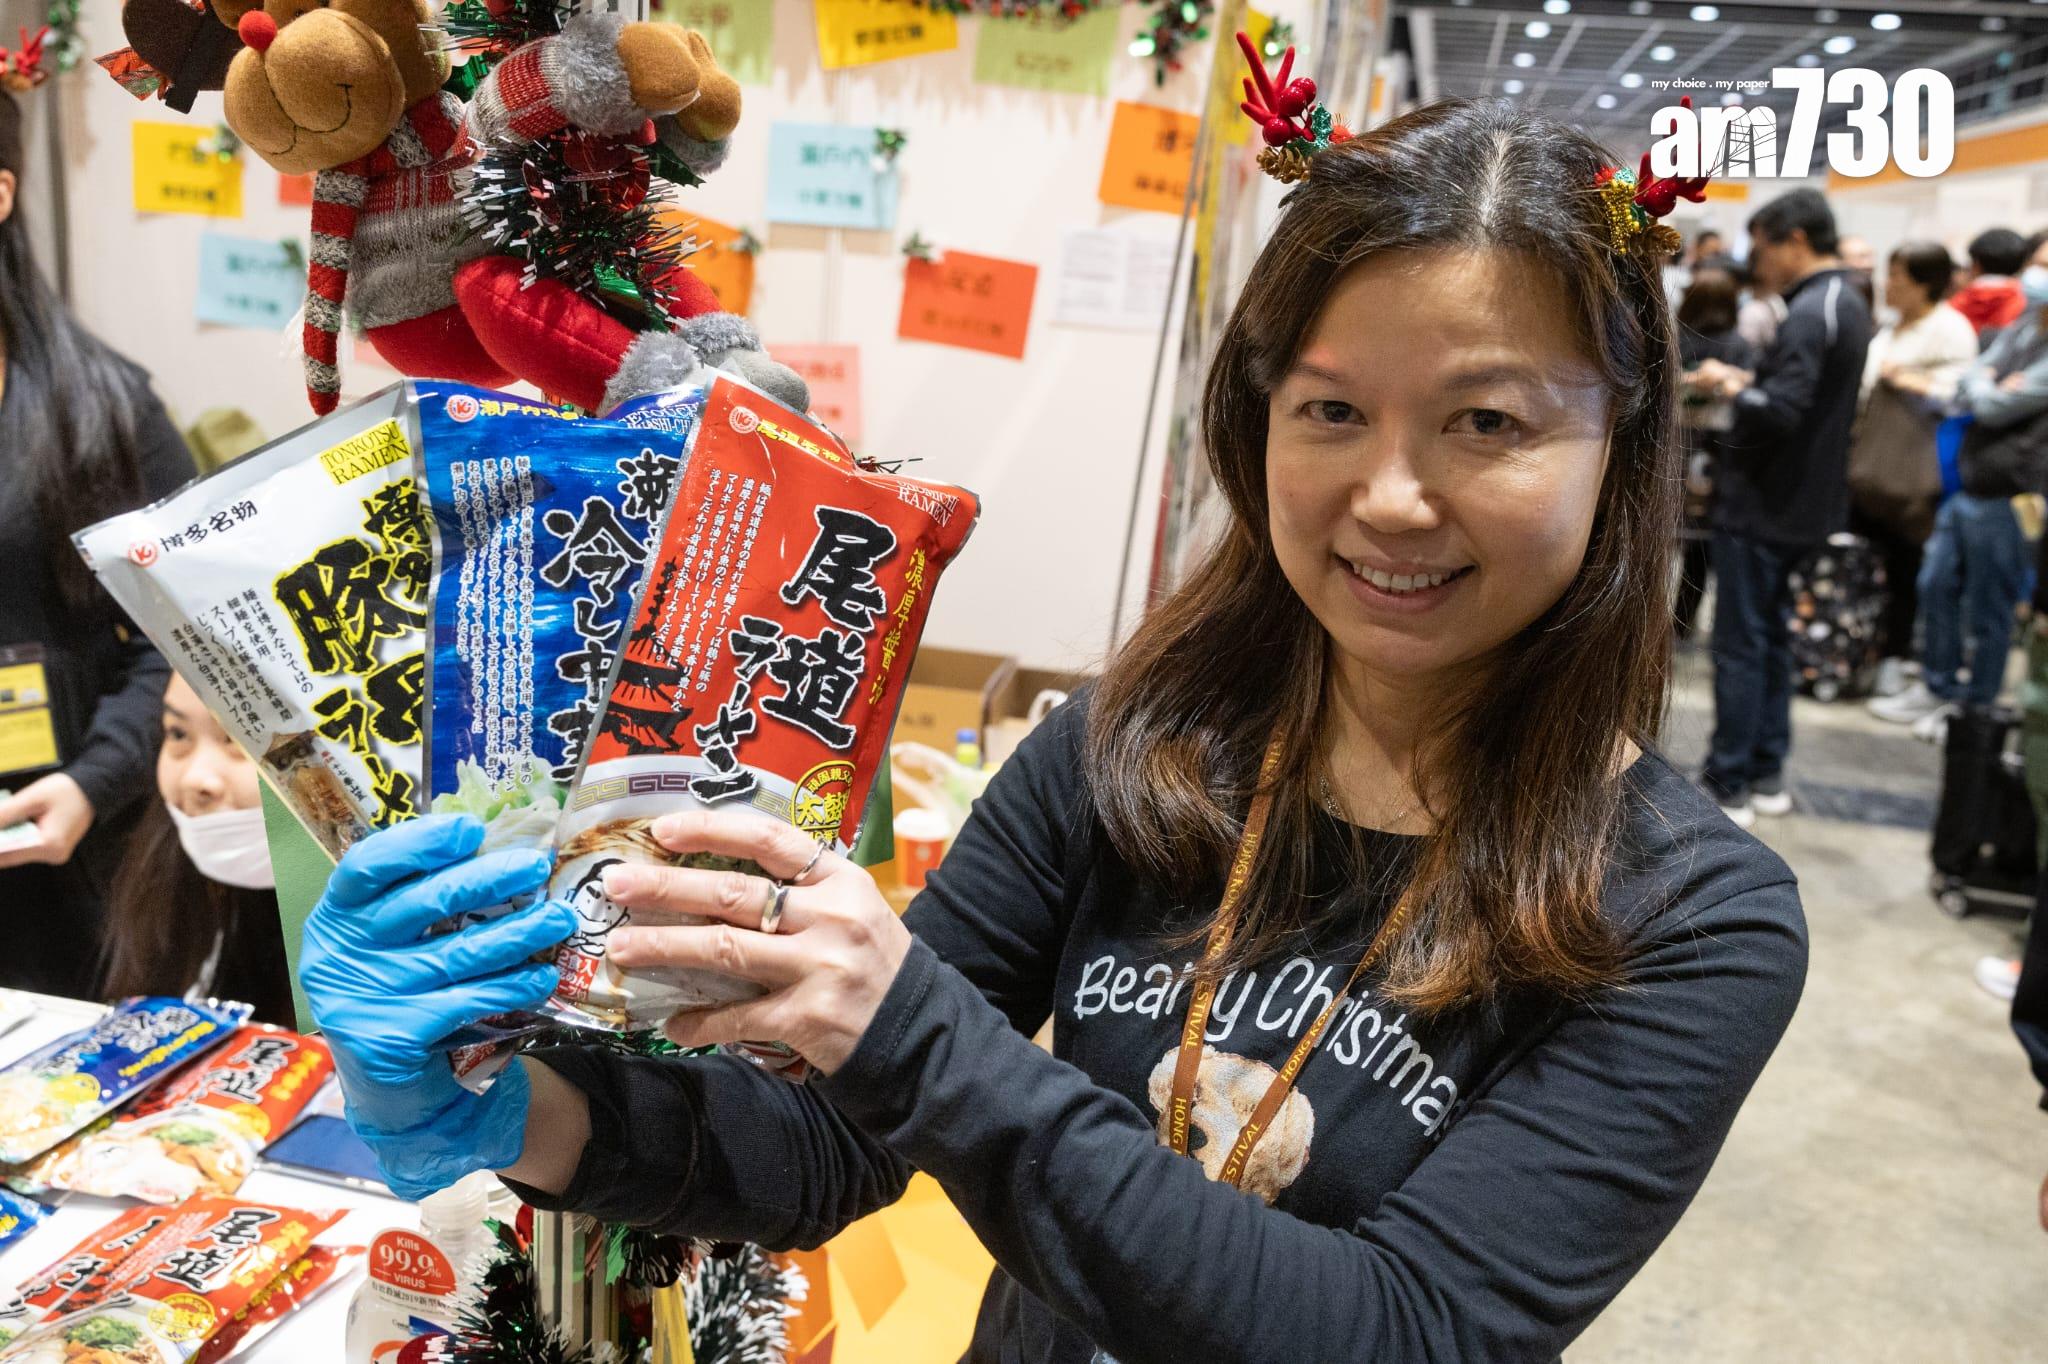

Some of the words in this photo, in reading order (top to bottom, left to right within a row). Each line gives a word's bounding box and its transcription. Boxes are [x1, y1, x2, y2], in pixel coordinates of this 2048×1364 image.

[320, 420, 399, 469] TONKOTSU
[332, 439, 411, 485] RAMEN
[158, 500, 259, 554] 博多名物
[896, 486, 952, 529] RAMEN
[760, 505, 897, 750] 尾道
[687, 615, 786, 804] ラーメン
[1256, 956, 1463, 1138] Christma
[1281, 1038, 1312, 1082] HONG
[396, 1235, 421, 1252] Kills
[393, 1272, 427, 1289] VIRUS
